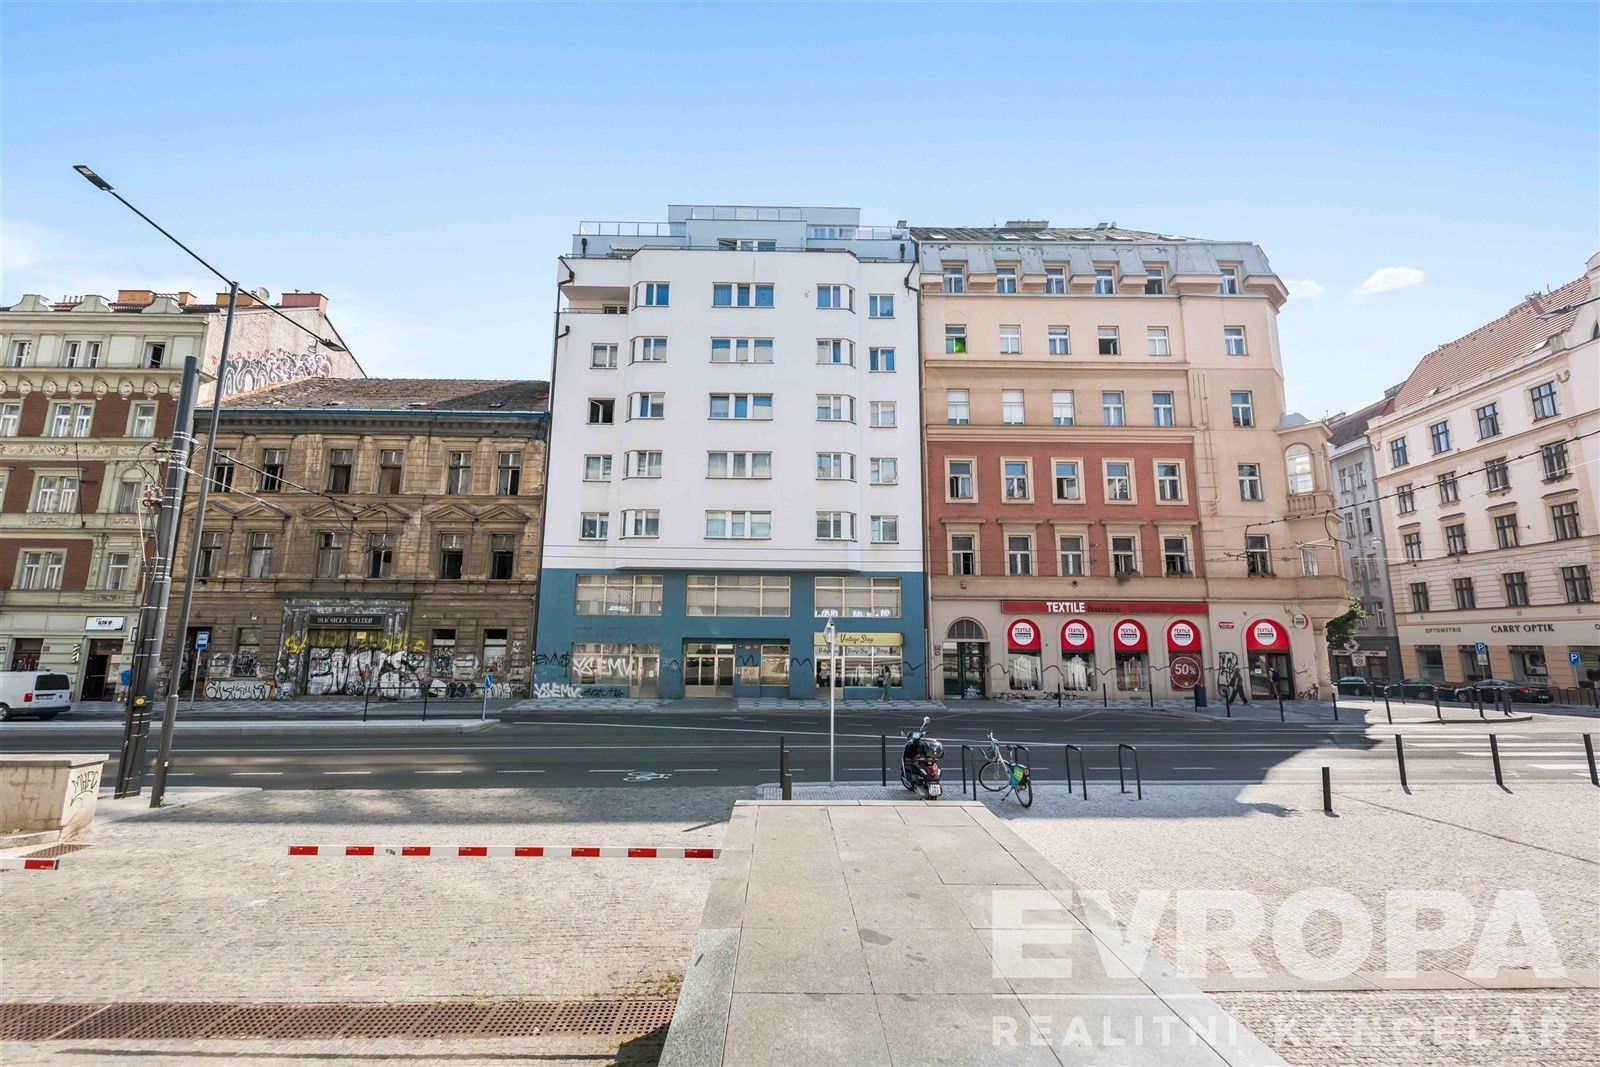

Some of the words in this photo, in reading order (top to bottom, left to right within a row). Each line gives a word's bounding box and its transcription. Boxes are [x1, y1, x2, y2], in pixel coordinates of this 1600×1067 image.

[1046, 602, 1085, 613] TEXTILE
[1490, 625, 1521, 633] CARRY
[1523, 624, 1555, 632] OPTIK
[840, 634, 859, 643] Vintage
[860, 634, 873, 643] Shop
[1571, 653, 1577, 661] P
[1175, 664, 1196, 675] 50%
